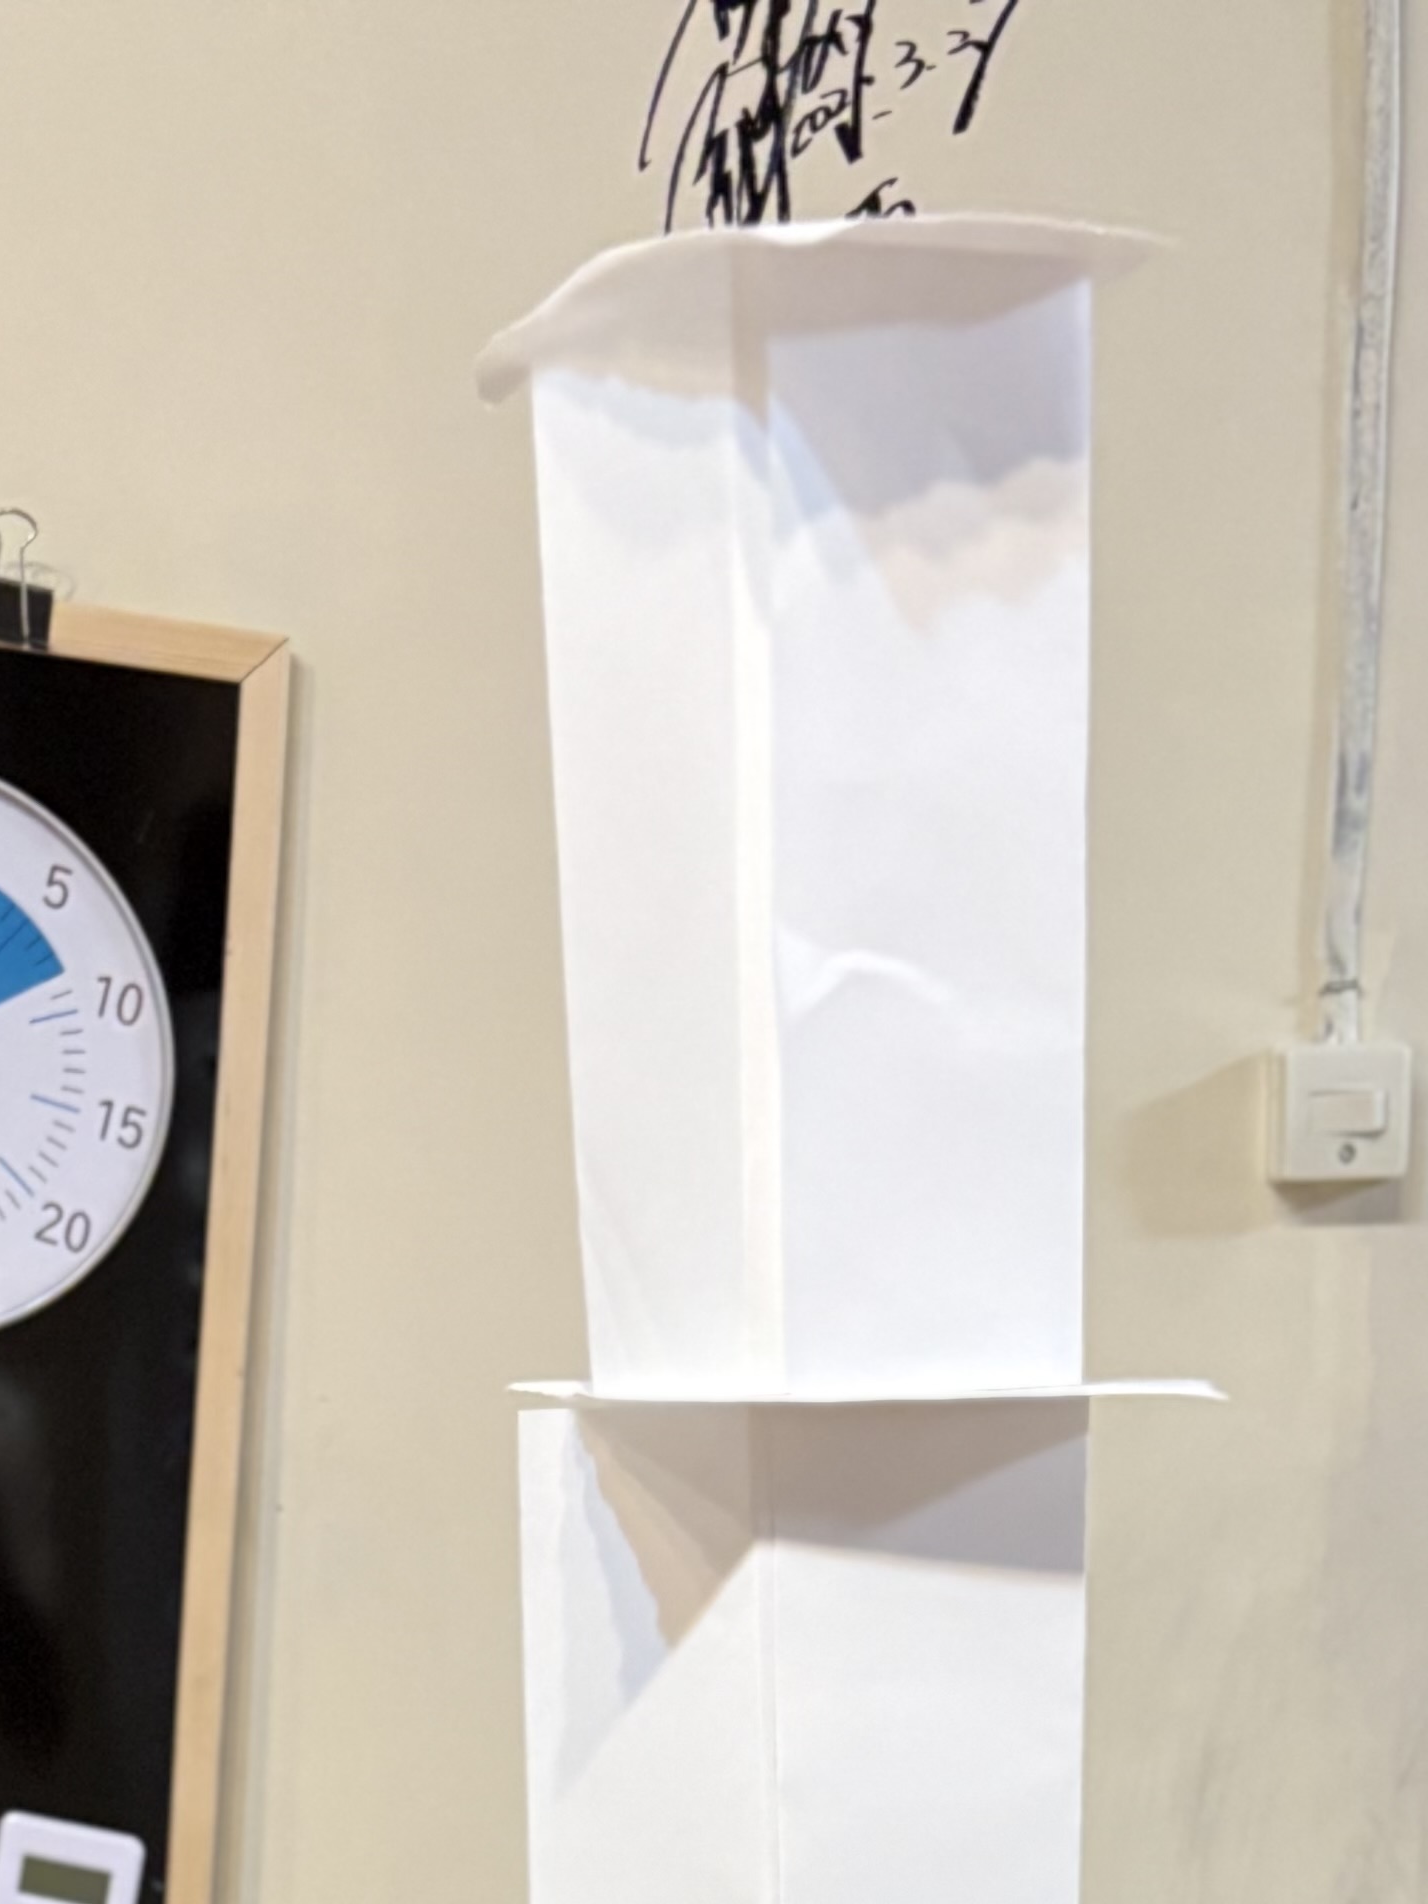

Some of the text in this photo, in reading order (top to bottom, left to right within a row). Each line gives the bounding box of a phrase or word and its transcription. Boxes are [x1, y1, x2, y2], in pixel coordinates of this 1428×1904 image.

[42, 864, 73, 909] 5
[96, 976, 143, 1026] 10
[98, 1099, 147, 1150] 15
[34, 1202, 91, 1253] 20
